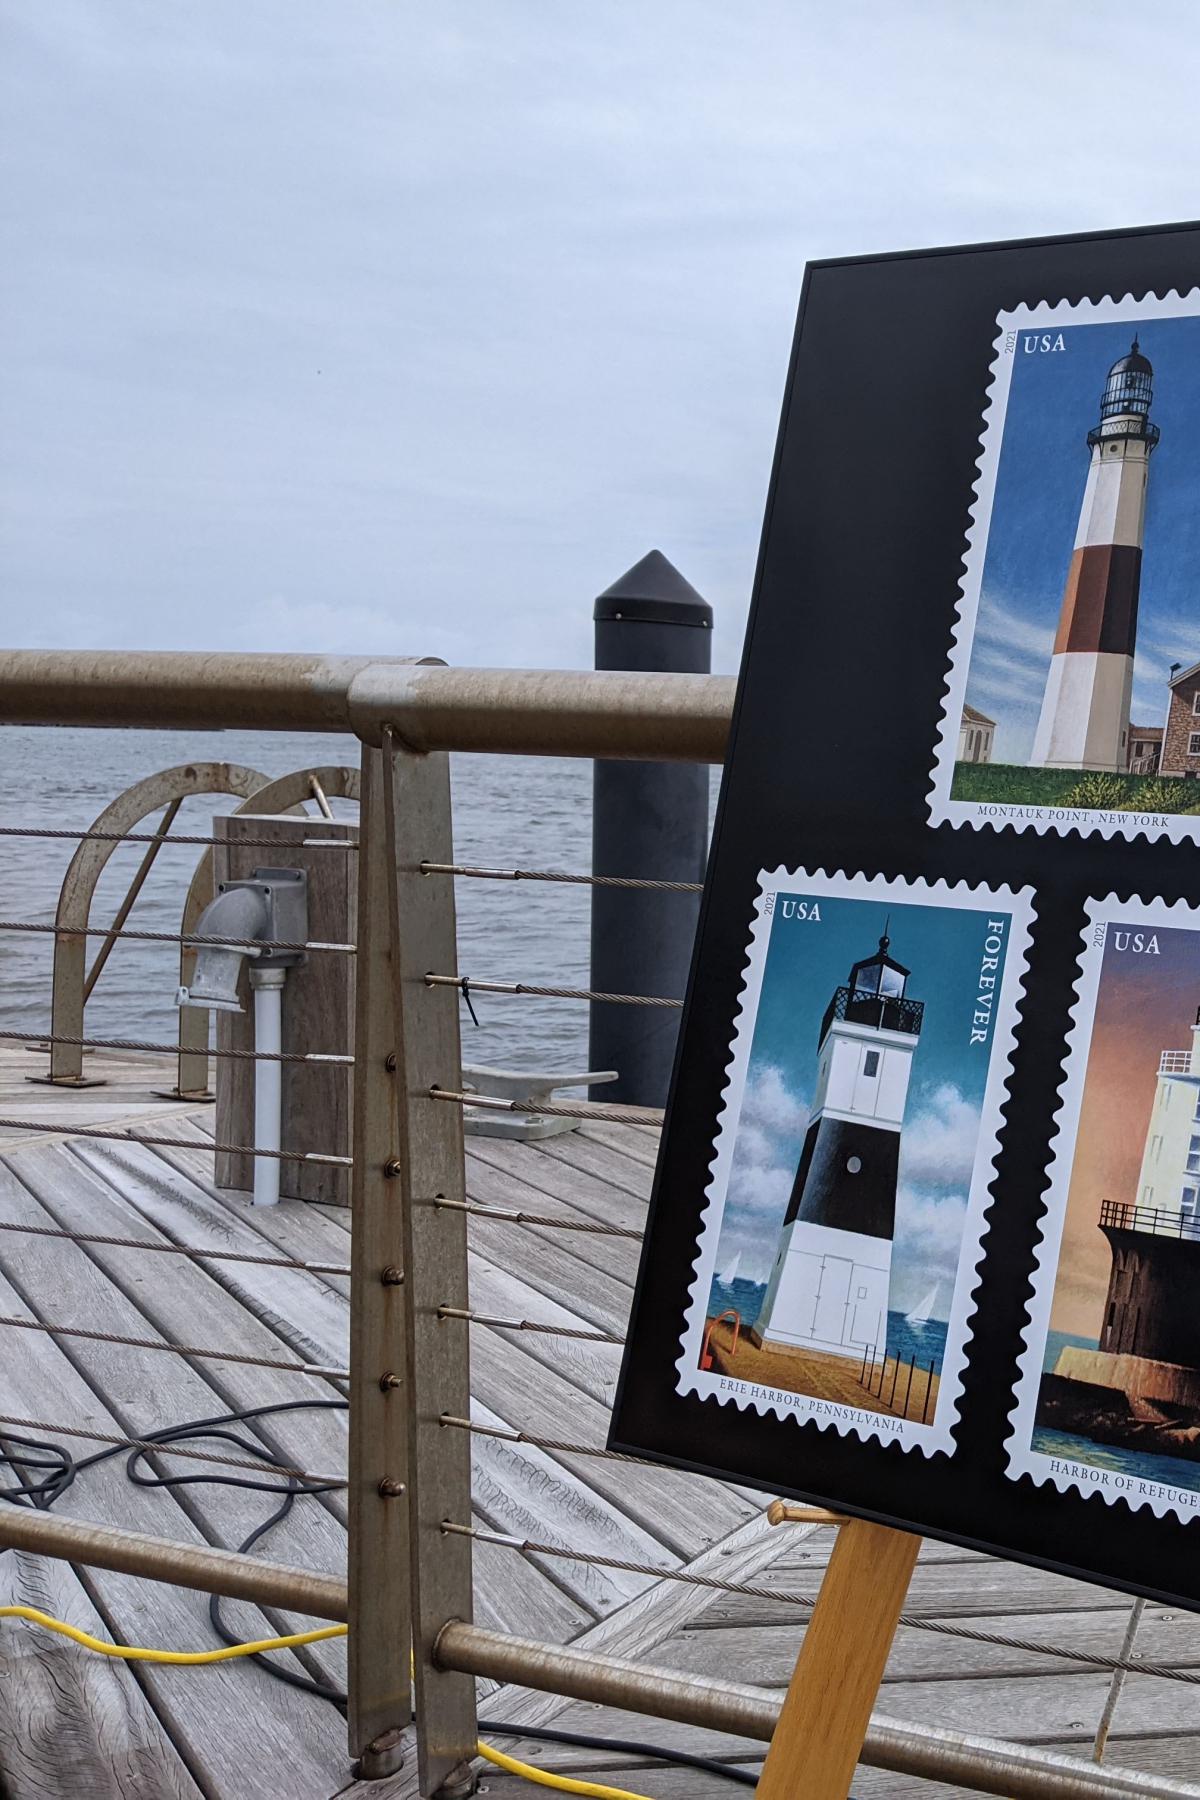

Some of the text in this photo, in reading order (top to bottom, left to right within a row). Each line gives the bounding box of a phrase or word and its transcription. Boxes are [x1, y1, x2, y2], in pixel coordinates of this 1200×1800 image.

[1004, 330, 1017, 354] 2021
[1023, 333, 1066, 354] USA
[977, 805, 1169, 828] MONTAUK POINT, NEW YORK
[764, 891, 776, 915] 2021
[781, 900, 822, 922] USA
[1092, 921, 1107, 948] 2021
[1114, 931, 1161, 955] USA
[969, 919, 1005, 1046] FOREVER
[720, 1378, 904, 1433] ERIE HARBOR, PENNSYLVANIA
[1050, 1460, 1110, 1486] HARBOR
[1114, 1476, 1134, 1490] OF
